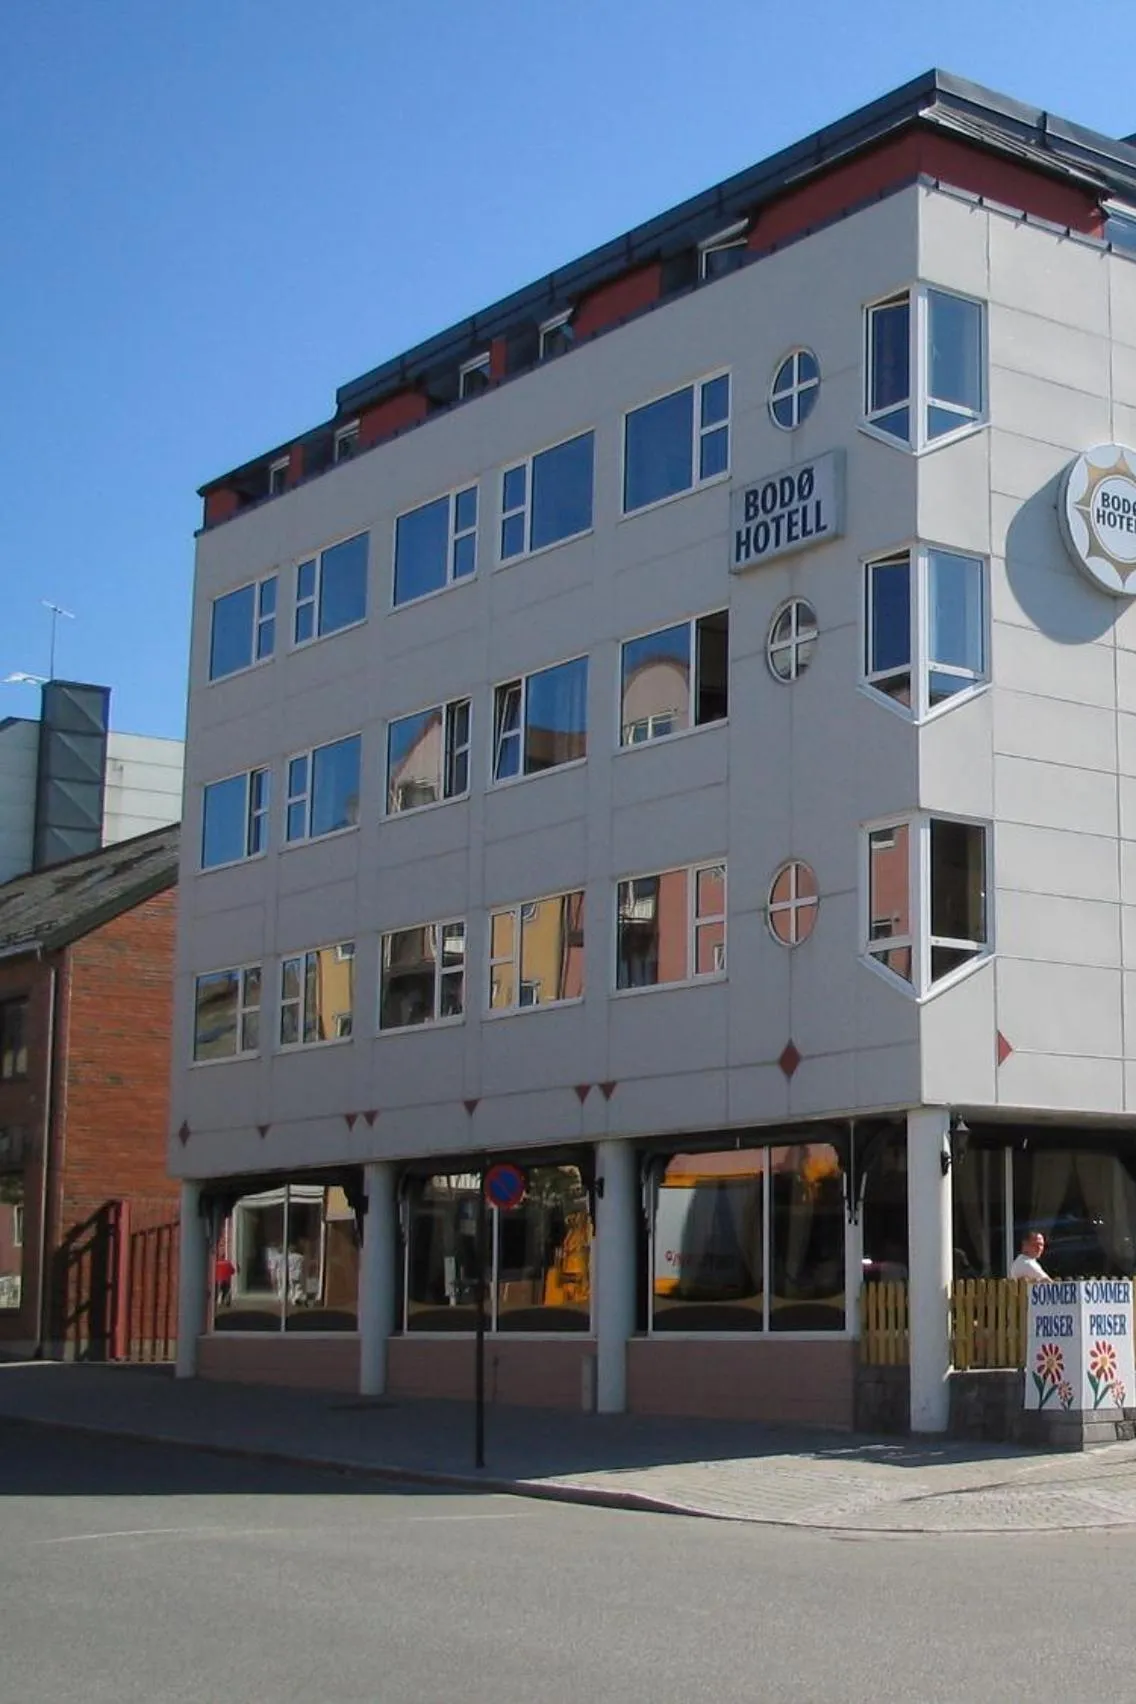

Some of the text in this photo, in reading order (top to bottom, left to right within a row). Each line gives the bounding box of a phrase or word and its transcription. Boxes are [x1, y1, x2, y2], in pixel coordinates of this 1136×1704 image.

[744, 465, 815, 523] BODØ
[735, 500, 828, 563] HOTELL
[1031, 1282, 1077, 1305] SOMMER
[1084, 1282, 1130, 1304] SOMMER
[1035, 1314, 1074, 1338] PRISER
[1089, 1314, 1126, 1336] PRISER
